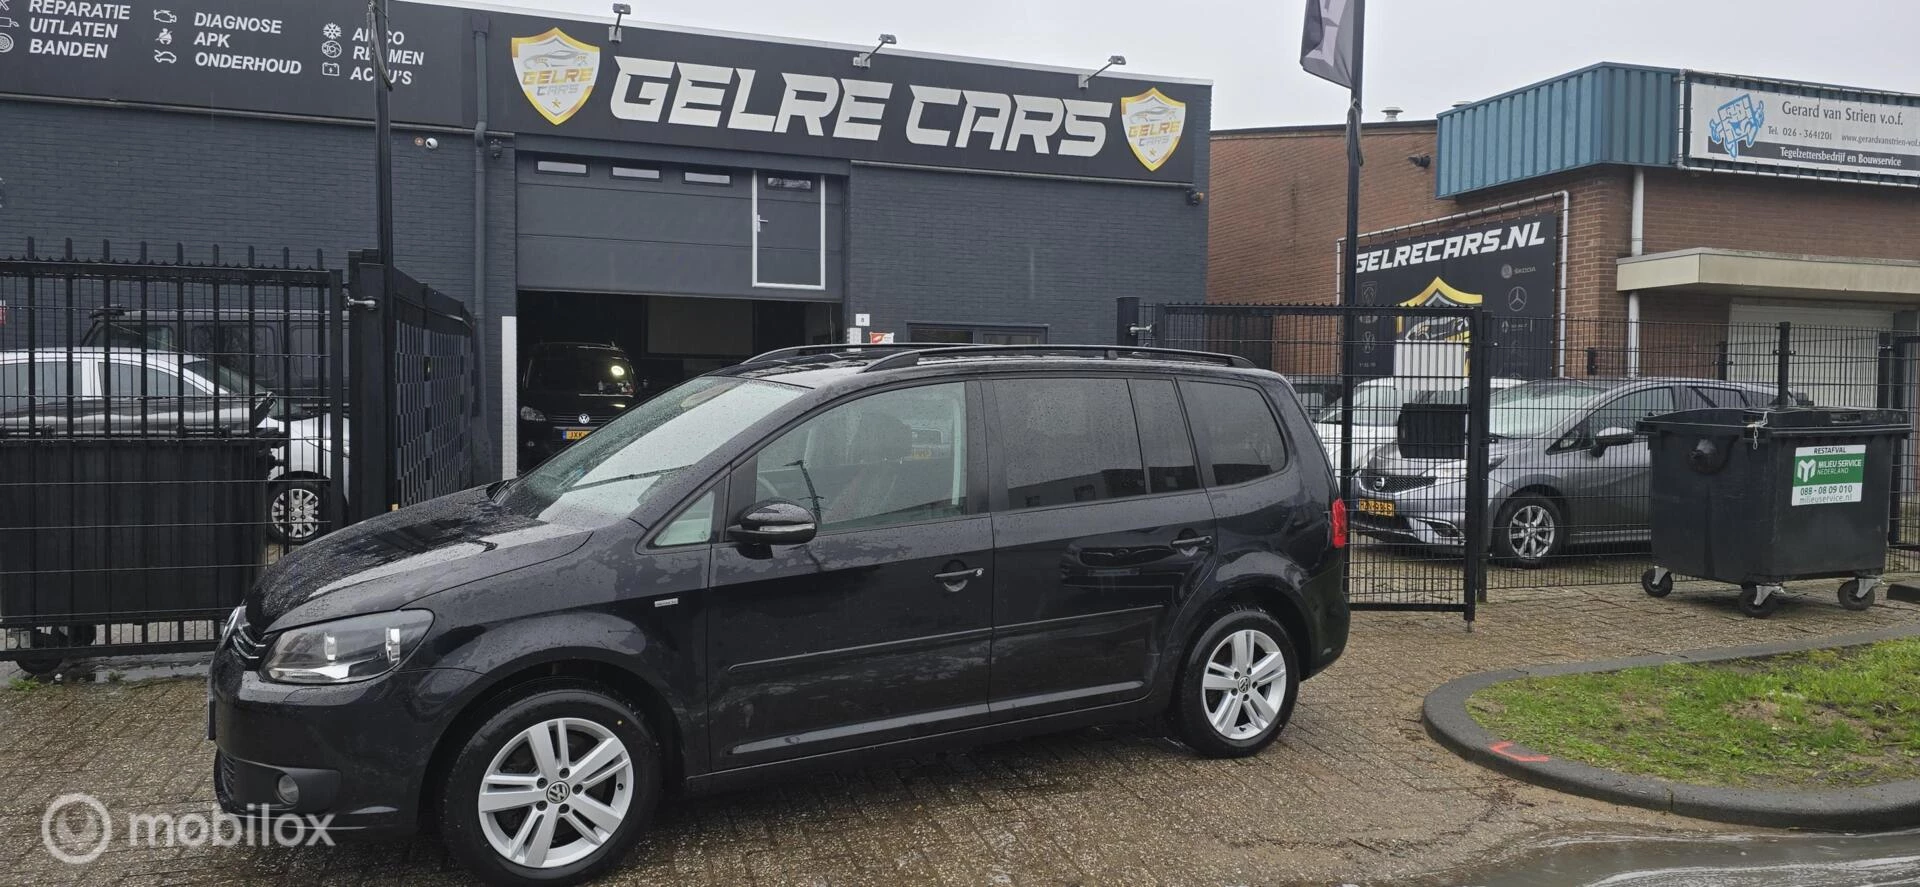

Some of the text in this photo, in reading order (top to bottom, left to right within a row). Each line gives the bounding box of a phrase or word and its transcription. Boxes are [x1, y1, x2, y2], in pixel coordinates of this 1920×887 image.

[29, 0, 131, 20] REPARATIE
[29, 17, 119, 39] UITLATEN
[194, 12, 282, 34] DIAGNOSE
[29, 38, 108, 59] BANDEN
[193, 31, 231, 48] APK
[195, 51, 302, 74] ONDERHOUD
[522, 67, 594, 85] GELRE
[537, 84, 579, 96] CARS
[609, 54, 1112, 157] GELRE CARS
[1782, 101, 1904, 126] Gerard van Strien v.o.f.
[1128, 120, 1181, 138] GELRE
[1782, 127, 1797, 137] 026
[1804, 129, 1832, 140] 3641201
[1780, 146, 1902, 168] Tegelzettersbedrijf en Bouwservice
[1817, 467, 1849, 475] NEDERLAND
[1838, 459, 1862, 467] SERVICE
[1800, 487, 1813, 496] 088
[1818, 486, 1827, 495] 08
[1828, 486, 1838, 494] 09
[1839, 485, 1853, 493] 010
[1800, 494, 1852, 504] milieuservice.nl
